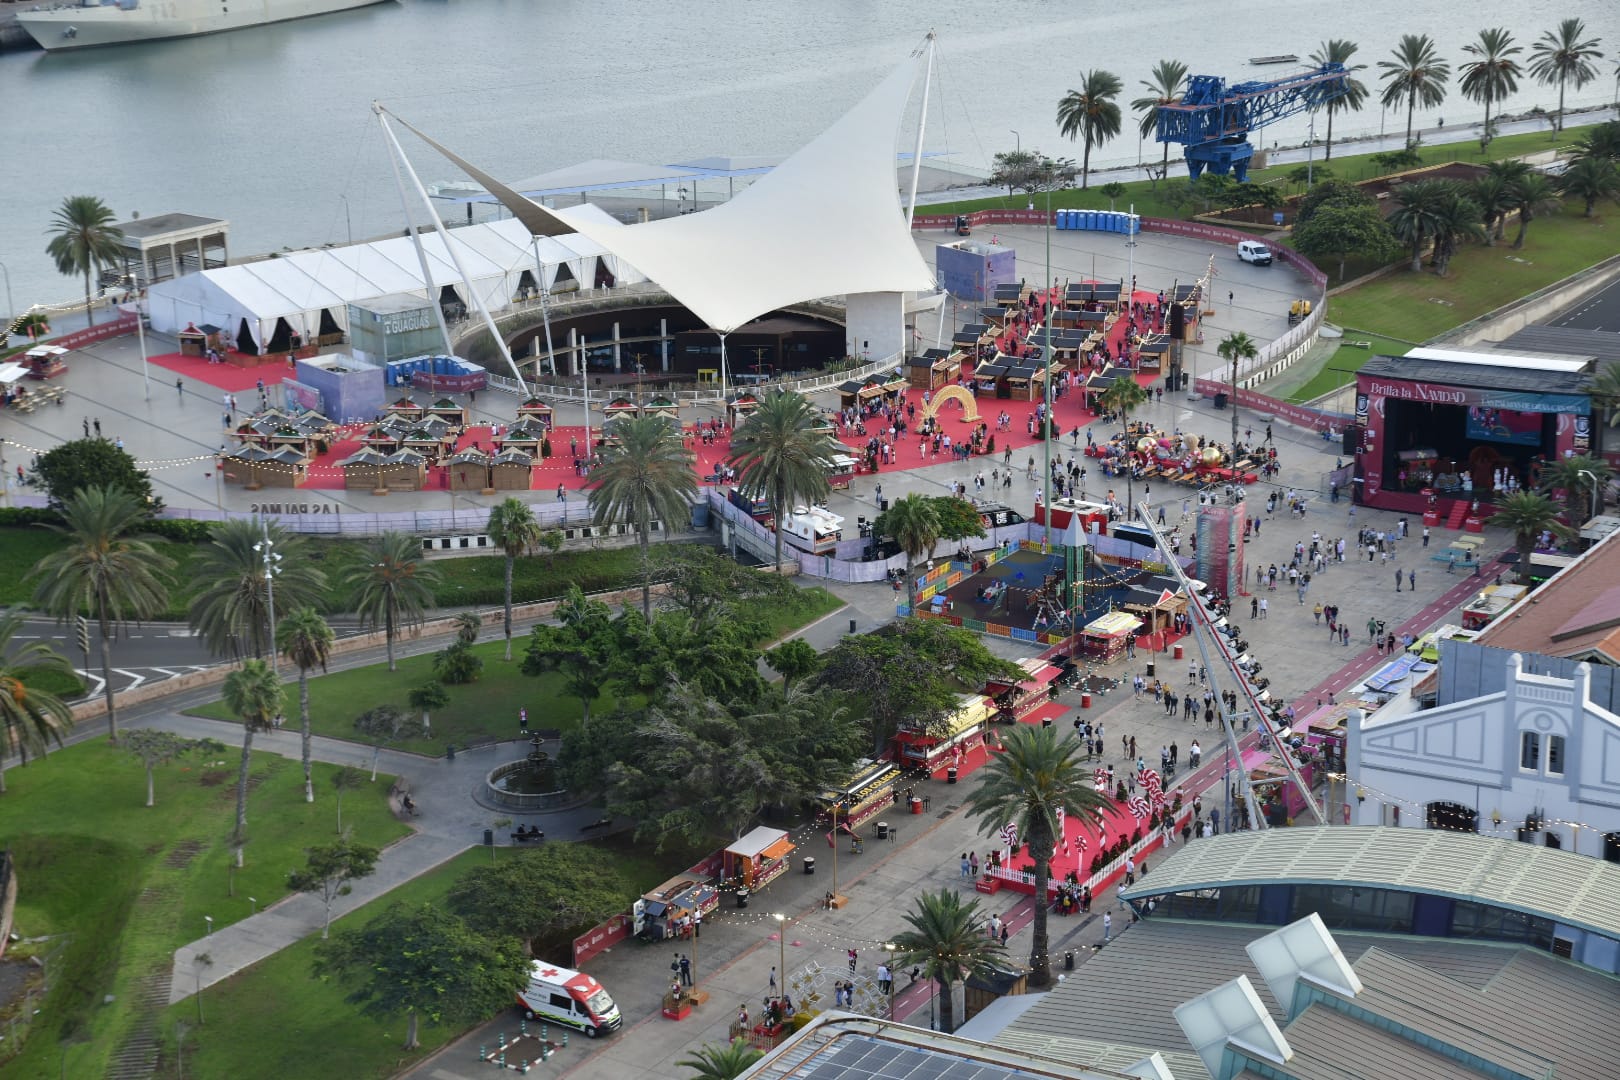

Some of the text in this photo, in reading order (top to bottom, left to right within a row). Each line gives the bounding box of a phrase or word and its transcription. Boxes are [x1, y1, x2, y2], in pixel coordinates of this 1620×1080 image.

[392, 318, 430, 334] GUAGUAS
[1370, 382, 1399, 397] Brilla
[1401, 387, 1412, 398] la
[869, 769, 902, 789] COLEGAS
